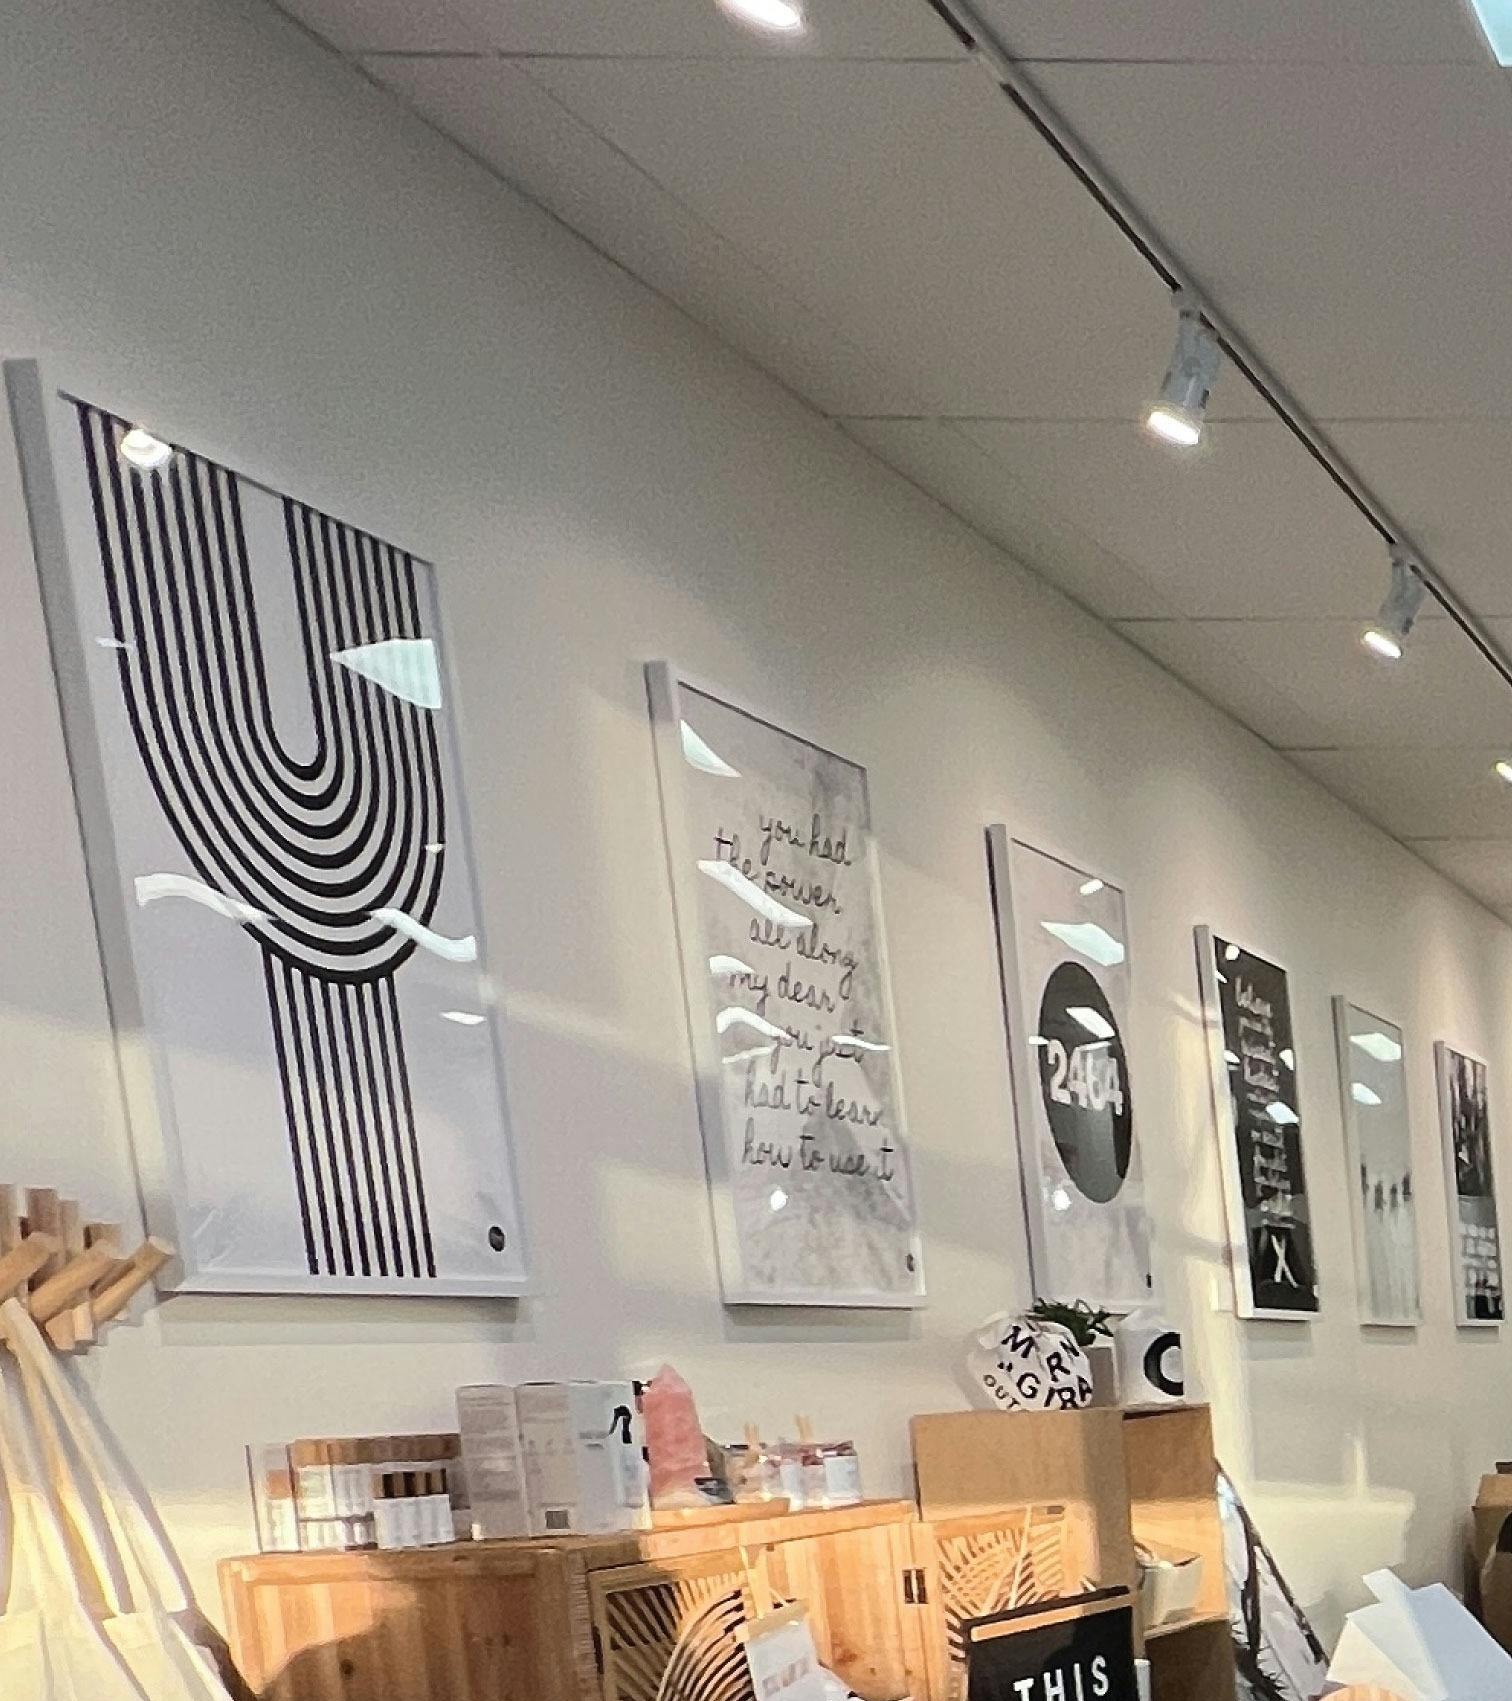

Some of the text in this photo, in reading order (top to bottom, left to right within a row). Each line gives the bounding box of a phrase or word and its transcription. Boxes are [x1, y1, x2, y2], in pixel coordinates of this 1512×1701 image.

[713, 826, 757, 880] the
[759, 814, 805, 865] you
[796, 922, 858, 999] along
[730, 962, 834, 1016] my dear
[744, 1058, 881, 1127] had to learn
[741, 1118, 793, 1168] how
[799, 1133, 824, 1171] to
